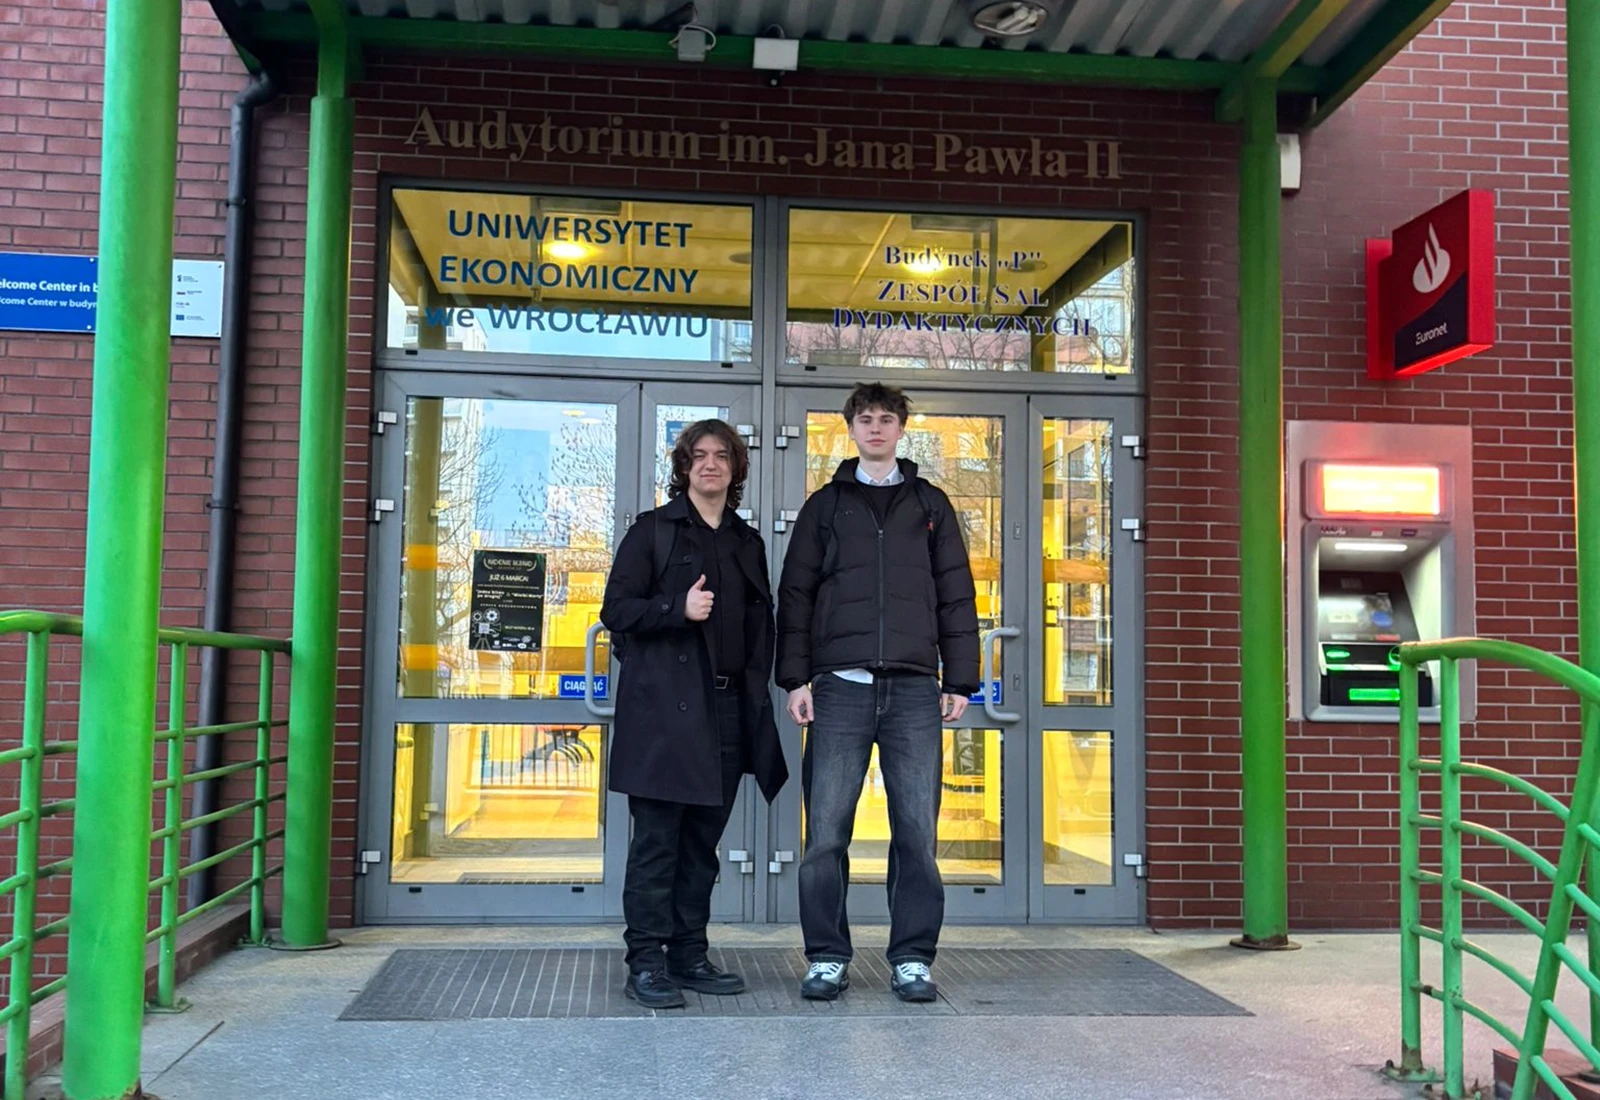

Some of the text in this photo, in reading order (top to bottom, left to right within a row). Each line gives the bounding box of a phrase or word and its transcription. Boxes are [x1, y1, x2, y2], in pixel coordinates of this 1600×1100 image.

[405, 106, 1123, 179] Audytorium im. Jana Pawła II
[449, 209, 693, 248] UNIWERSYTET
[884, 246, 988, 272] Budynek
[39, 280, 77, 292] Center
[79, 282, 91, 293] in
[440, 256, 700, 294] EKONOMICZNY
[27, 297, 58, 306] Center
[994, 282, 1050, 307] SAL
[424, 303, 709, 338] we WROCŁAWIU
[832, 307, 1091, 337] DYDAKTYCZNYCH
[1415, 321, 1448, 347] Euronet
